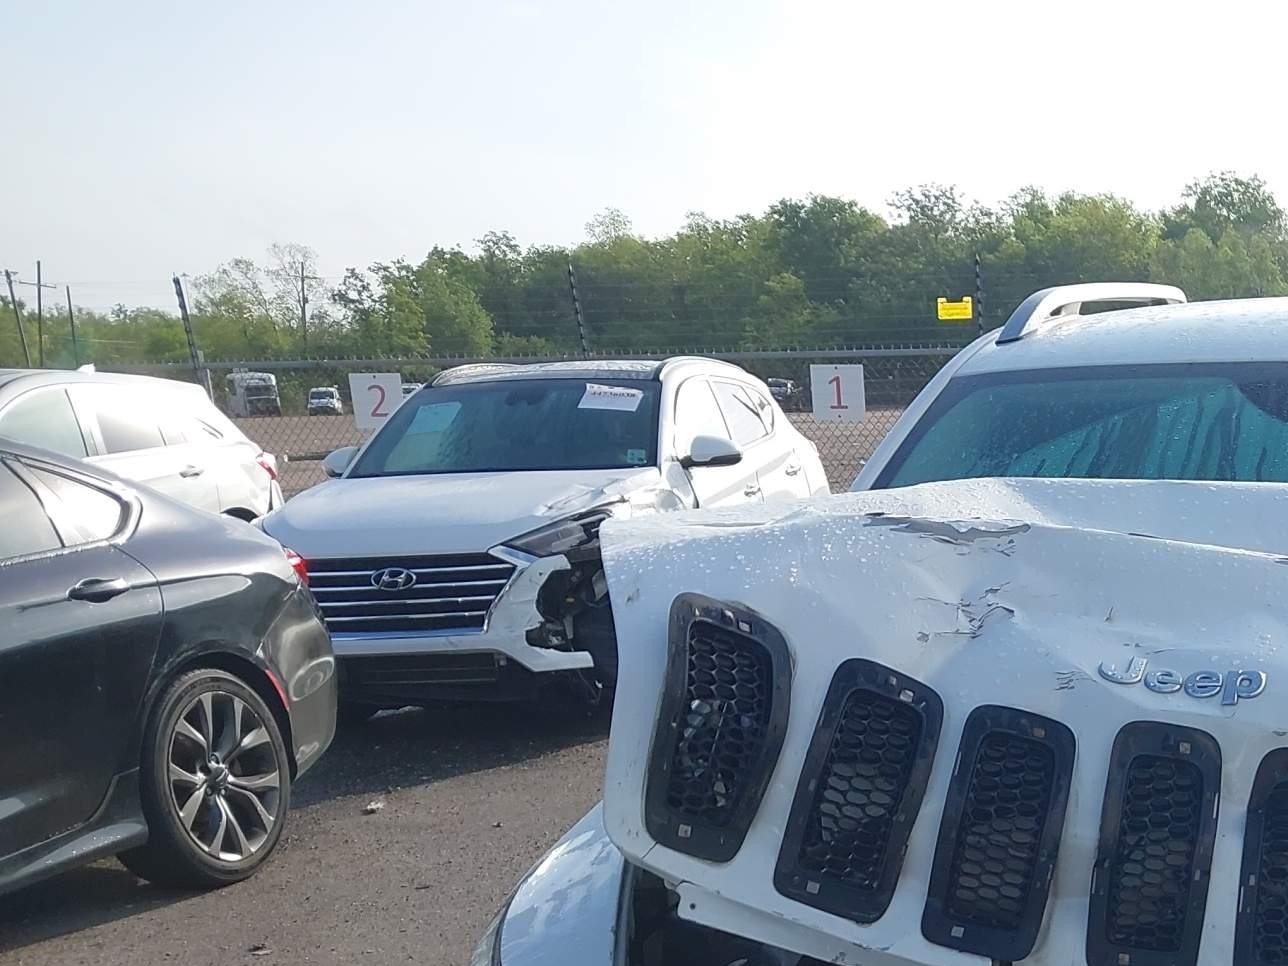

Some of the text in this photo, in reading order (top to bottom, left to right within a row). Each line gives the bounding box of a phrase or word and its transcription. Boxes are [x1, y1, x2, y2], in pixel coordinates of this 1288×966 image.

[367, 384, 390, 418] 2
[828, 375, 849, 410] 1
[1097, 655, 1267, 706] Jeep
